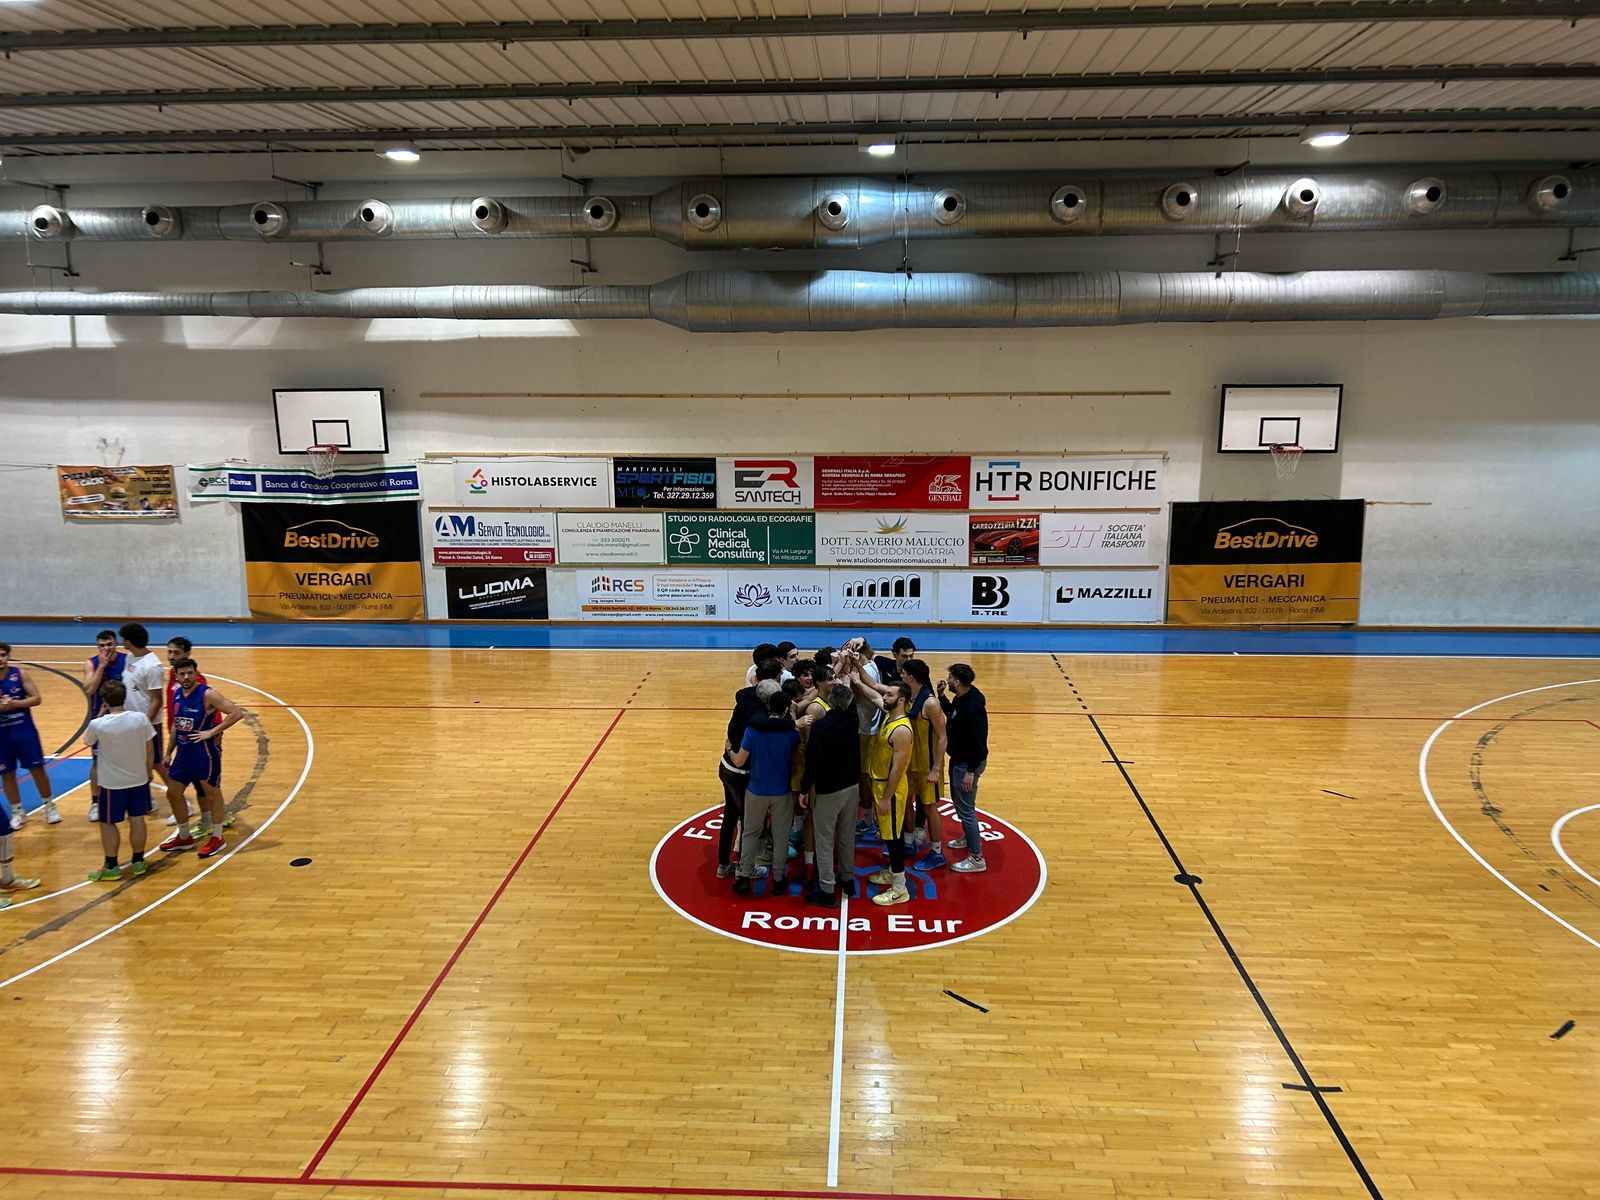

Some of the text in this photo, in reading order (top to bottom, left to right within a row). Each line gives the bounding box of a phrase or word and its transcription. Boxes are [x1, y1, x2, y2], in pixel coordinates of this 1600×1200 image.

[735, 460, 800, 488] ER
[230, 478, 252, 486] Roma
[265, 480, 289, 489] Banca
[290, 480, 299, 489] di
[330, 479, 378, 490] Cooperativo
[380, 479, 388, 488] di
[389, 478, 413, 487] Roma
[491, 477, 597, 487] HISTOLABSERVICE
[975, 470, 1156, 491] HTR BONIFICHE
[734, 490, 800, 502] SANTECH
[1016, 518, 1037, 529] IZZI
[708, 528, 747, 538] Clinical
[284, 531, 380, 549] BestDrive
[708, 538, 750, 548] Medical
[821, 537, 964, 546] DOTT. SAVERIO MALUCCIO
[1214, 530, 1318, 549] BestDrive
[708, 548, 764, 561] Consulting
[830, 548, 955, 556] STUDIO DI ODONTOIATRIA
[295, 573, 372, 586] VERGARI
[612, 579, 644, 592] RES
[1224, 574, 1304, 588] VERGARI
[458, 576, 534, 600] LUDMA
[776, 584, 823, 594] Ken Move Fly
[1078, 588, 1152, 599] MAZZILLI
[280, 592, 392, 600] PNEUMATICI MECCANICA
[776, 596, 822, 606] VIAGGI
[1201, 595, 1326, 604] PNEUMATICI MECCANICA
[842, 599, 921, 611] EUROTTICA
[740, 910, 964, 934] Roma Eur
